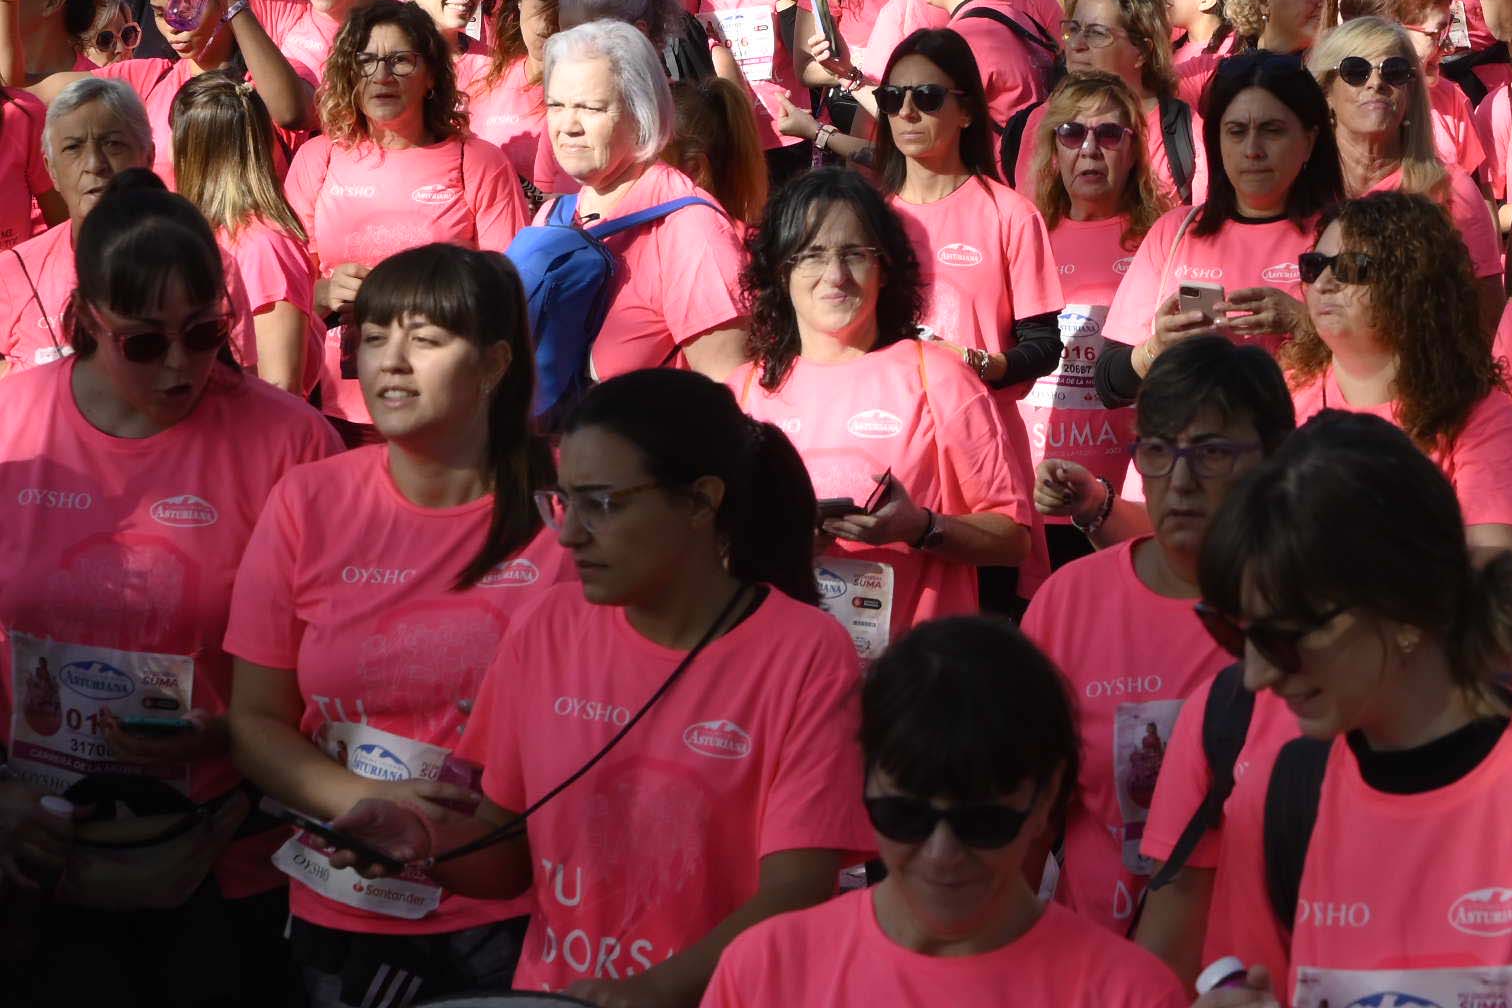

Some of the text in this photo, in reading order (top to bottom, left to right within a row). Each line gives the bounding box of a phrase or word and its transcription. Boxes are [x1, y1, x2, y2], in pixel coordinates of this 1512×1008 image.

[1033, 419, 1119, 449] SUMA
[18, 488, 93, 511] OYSHO
[1086, 674, 1163, 699] OYSHO
[554, 695, 631, 727] OYSHO
[364, 883, 426, 906] Santander
